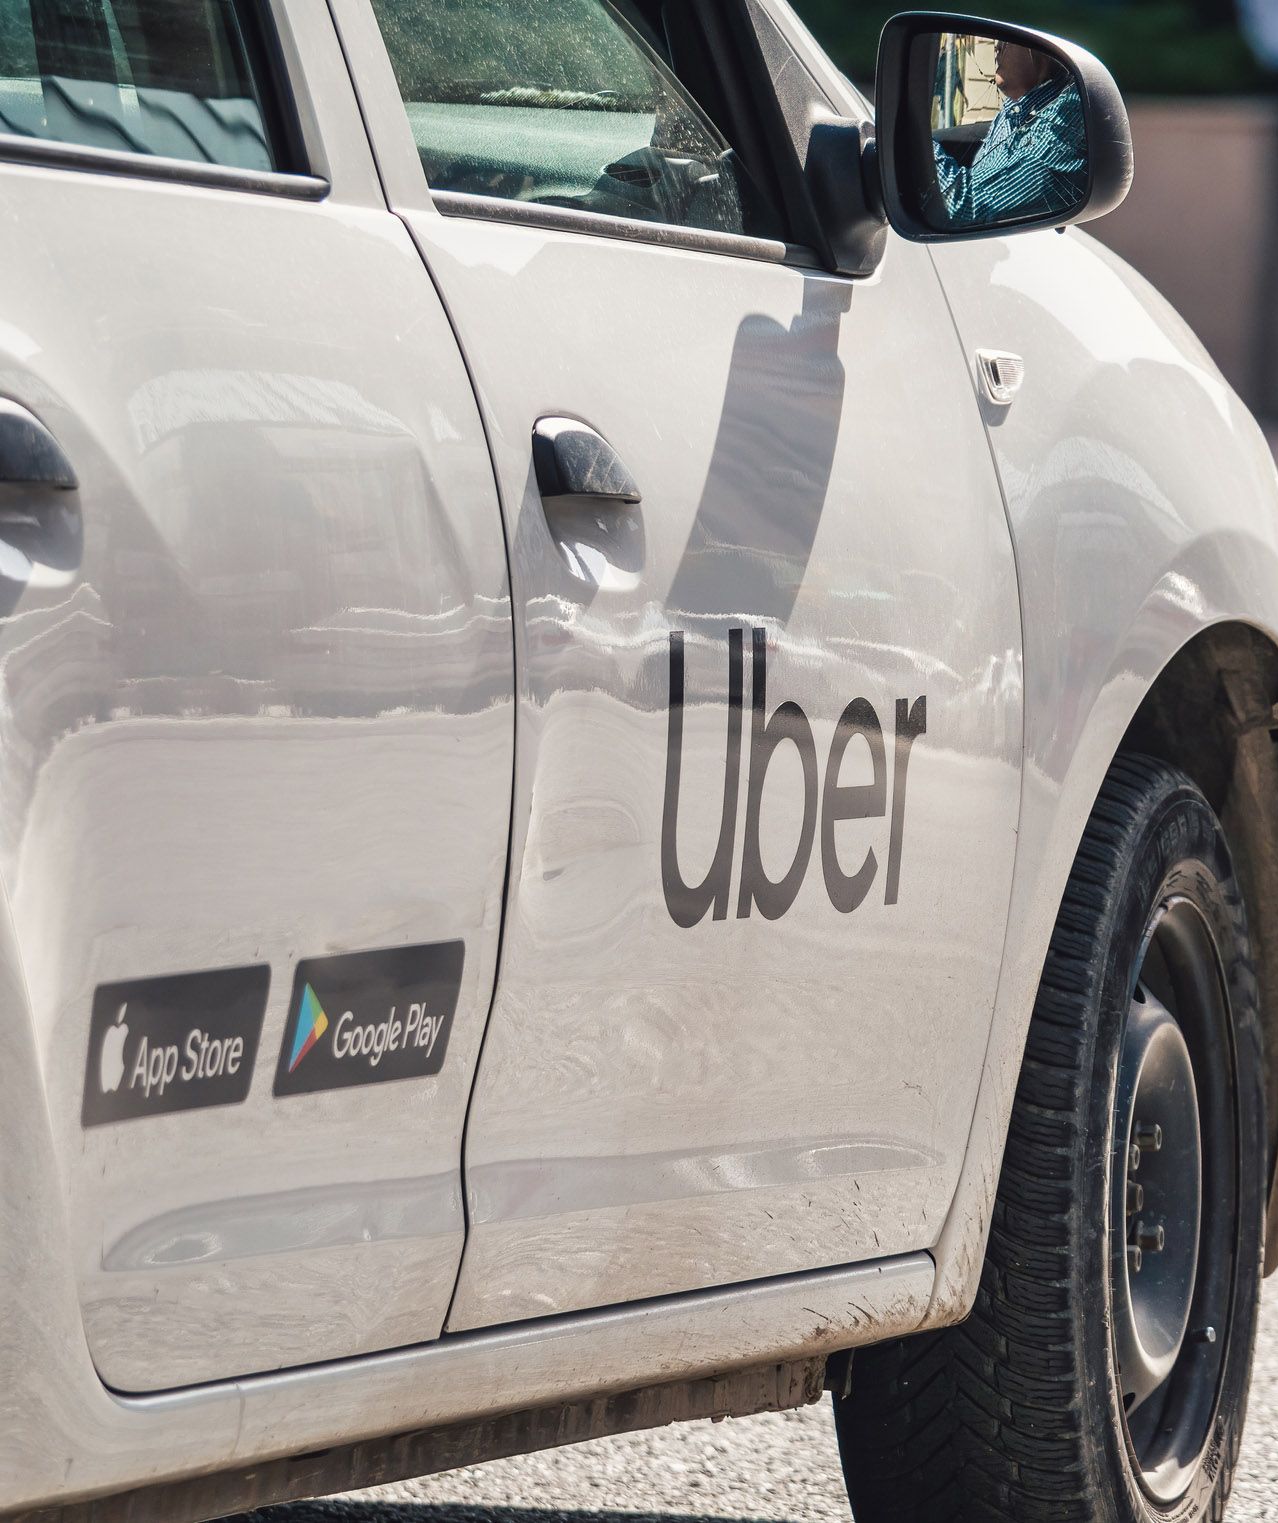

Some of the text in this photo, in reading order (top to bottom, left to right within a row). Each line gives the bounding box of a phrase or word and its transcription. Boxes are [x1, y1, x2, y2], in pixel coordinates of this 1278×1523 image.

[661, 627, 926, 928] Uber
[130, 1028, 244, 1098] App Store
[333, 1002, 445, 1067] Google Play
